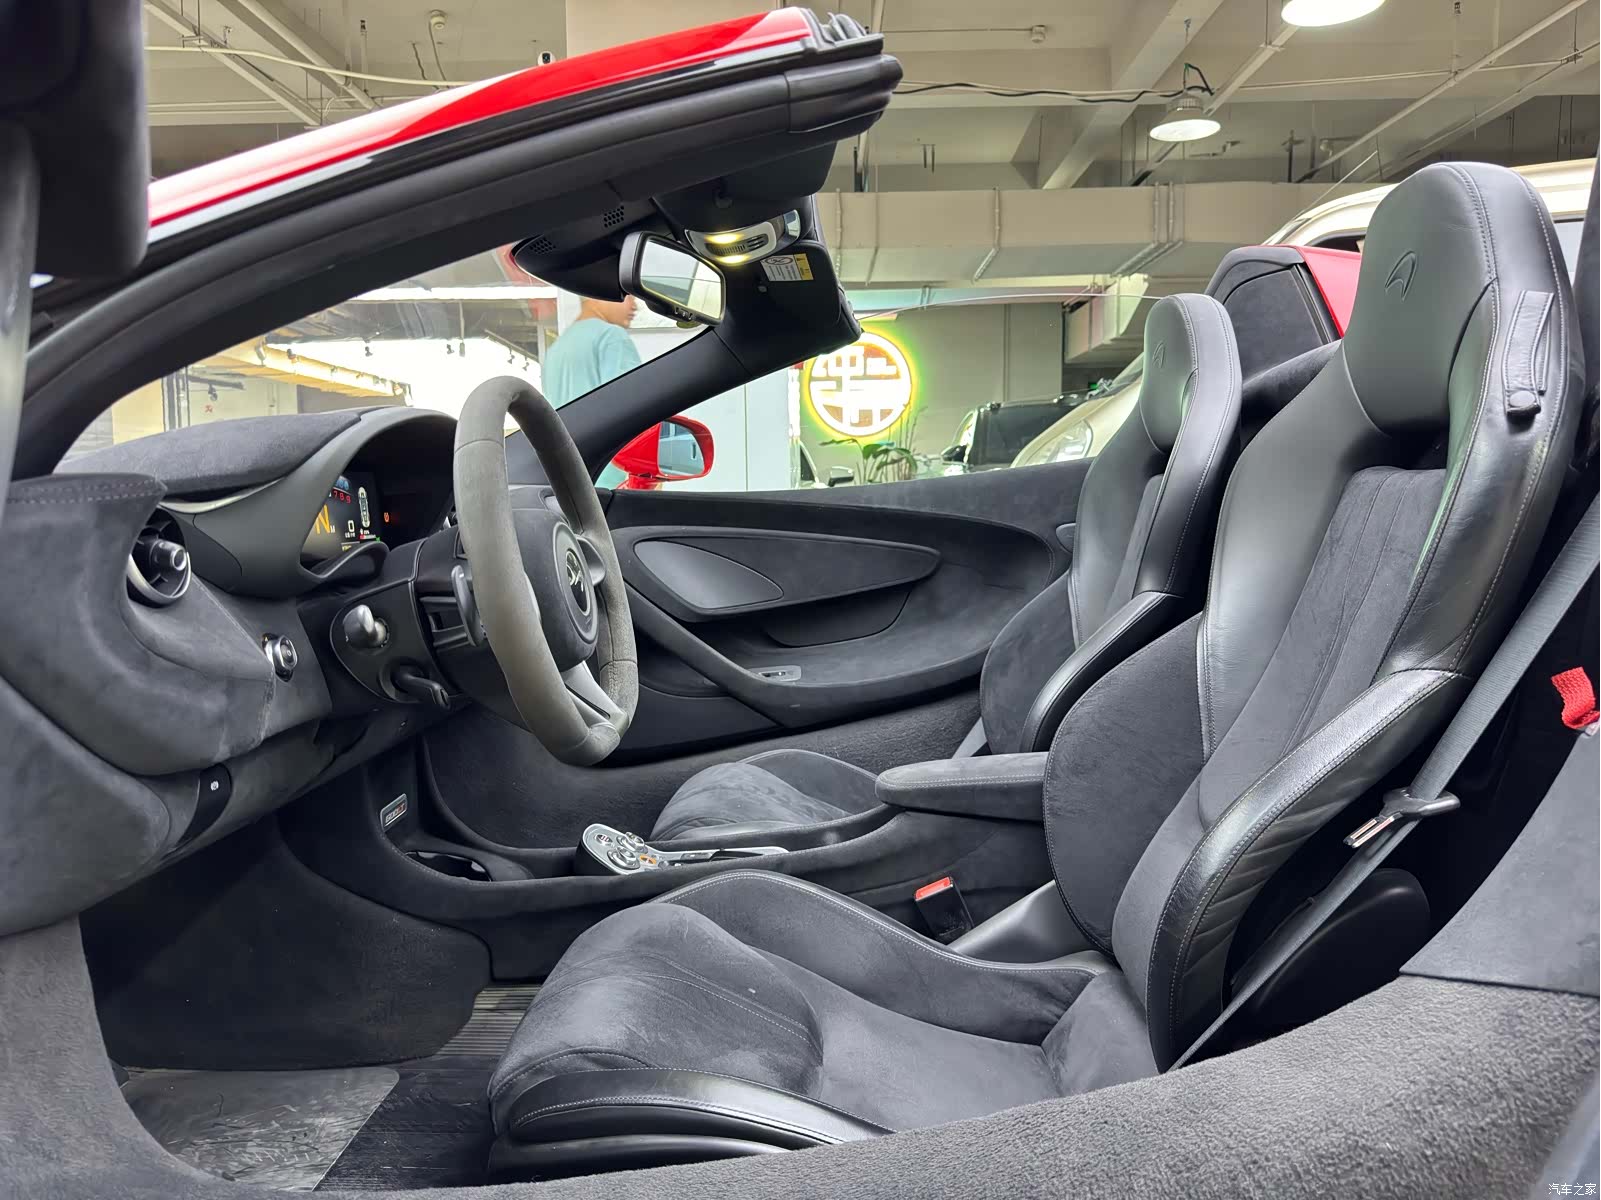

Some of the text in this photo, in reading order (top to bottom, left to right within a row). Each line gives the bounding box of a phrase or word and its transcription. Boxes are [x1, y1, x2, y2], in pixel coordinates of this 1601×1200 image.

[339, 492, 345, 501] 8
[345, 495, 351, 504] 9
[315, 504, 331, 535] N
[347, 519, 355, 533] 0
